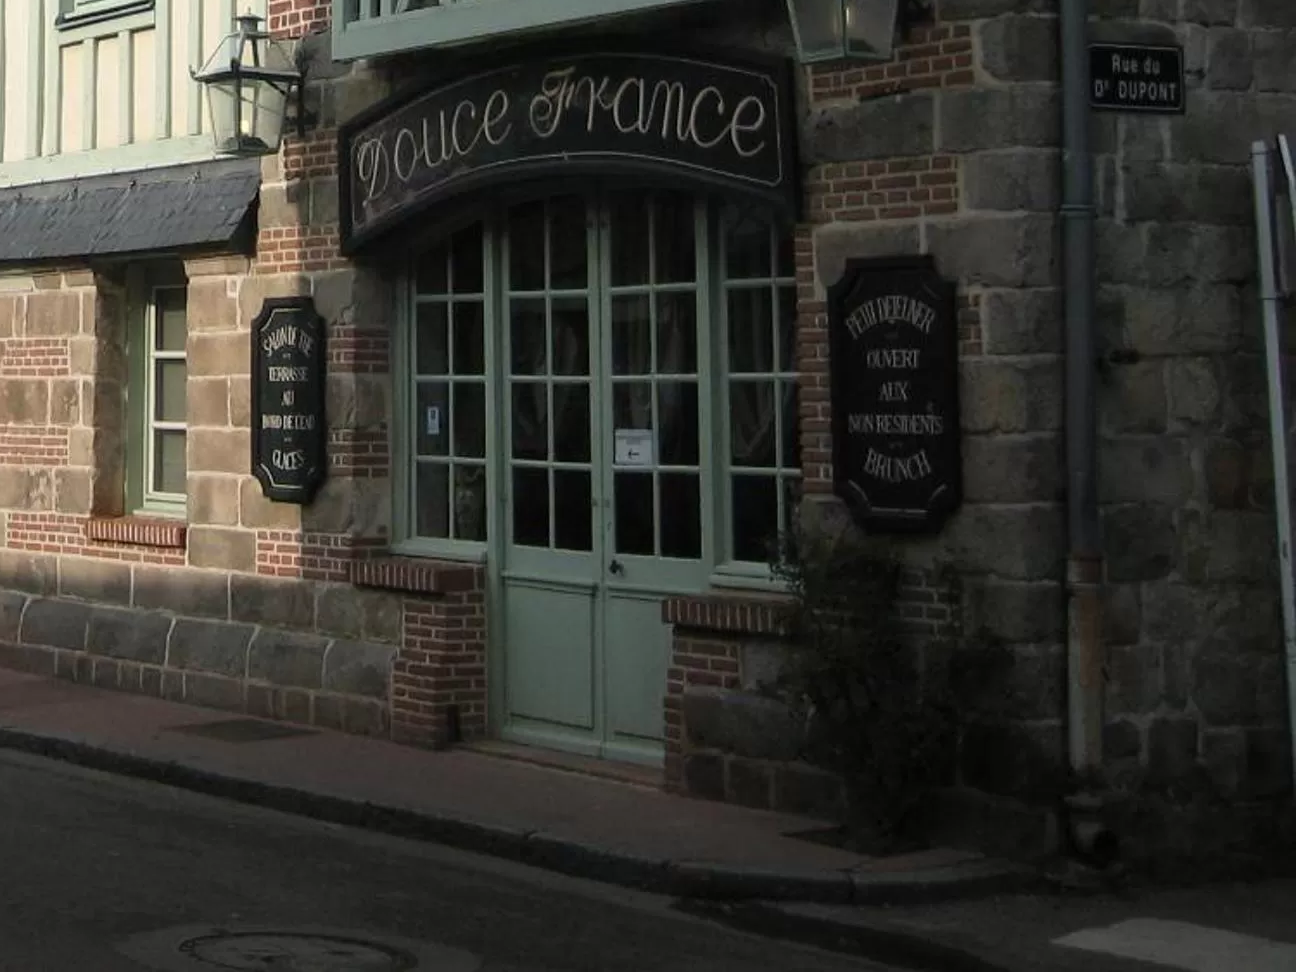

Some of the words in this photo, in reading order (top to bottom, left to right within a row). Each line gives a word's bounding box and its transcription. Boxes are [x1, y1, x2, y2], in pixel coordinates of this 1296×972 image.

[1112, 53, 1139, 73] Rue
[1144, 55, 1161, 75] du
[1118, 80, 1177, 101] DUPONT
[356, 88, 513, 209] Douce
[529, 65, 768, 158] France
[844, 299, 877, 341] PETIT
[263, 324, 288, 358] SALON
[866, 347, 921, 369] OUVERT
[268, 365, 309, 382] TERRASSE
[280, 389, 295, 407] AU
[878, 380, 910, 402] AUX
[848, 413, 874, 433] NON
[272, 448, 305, 471] GLACES
[863, 447, 932, 483] BRUNCH
